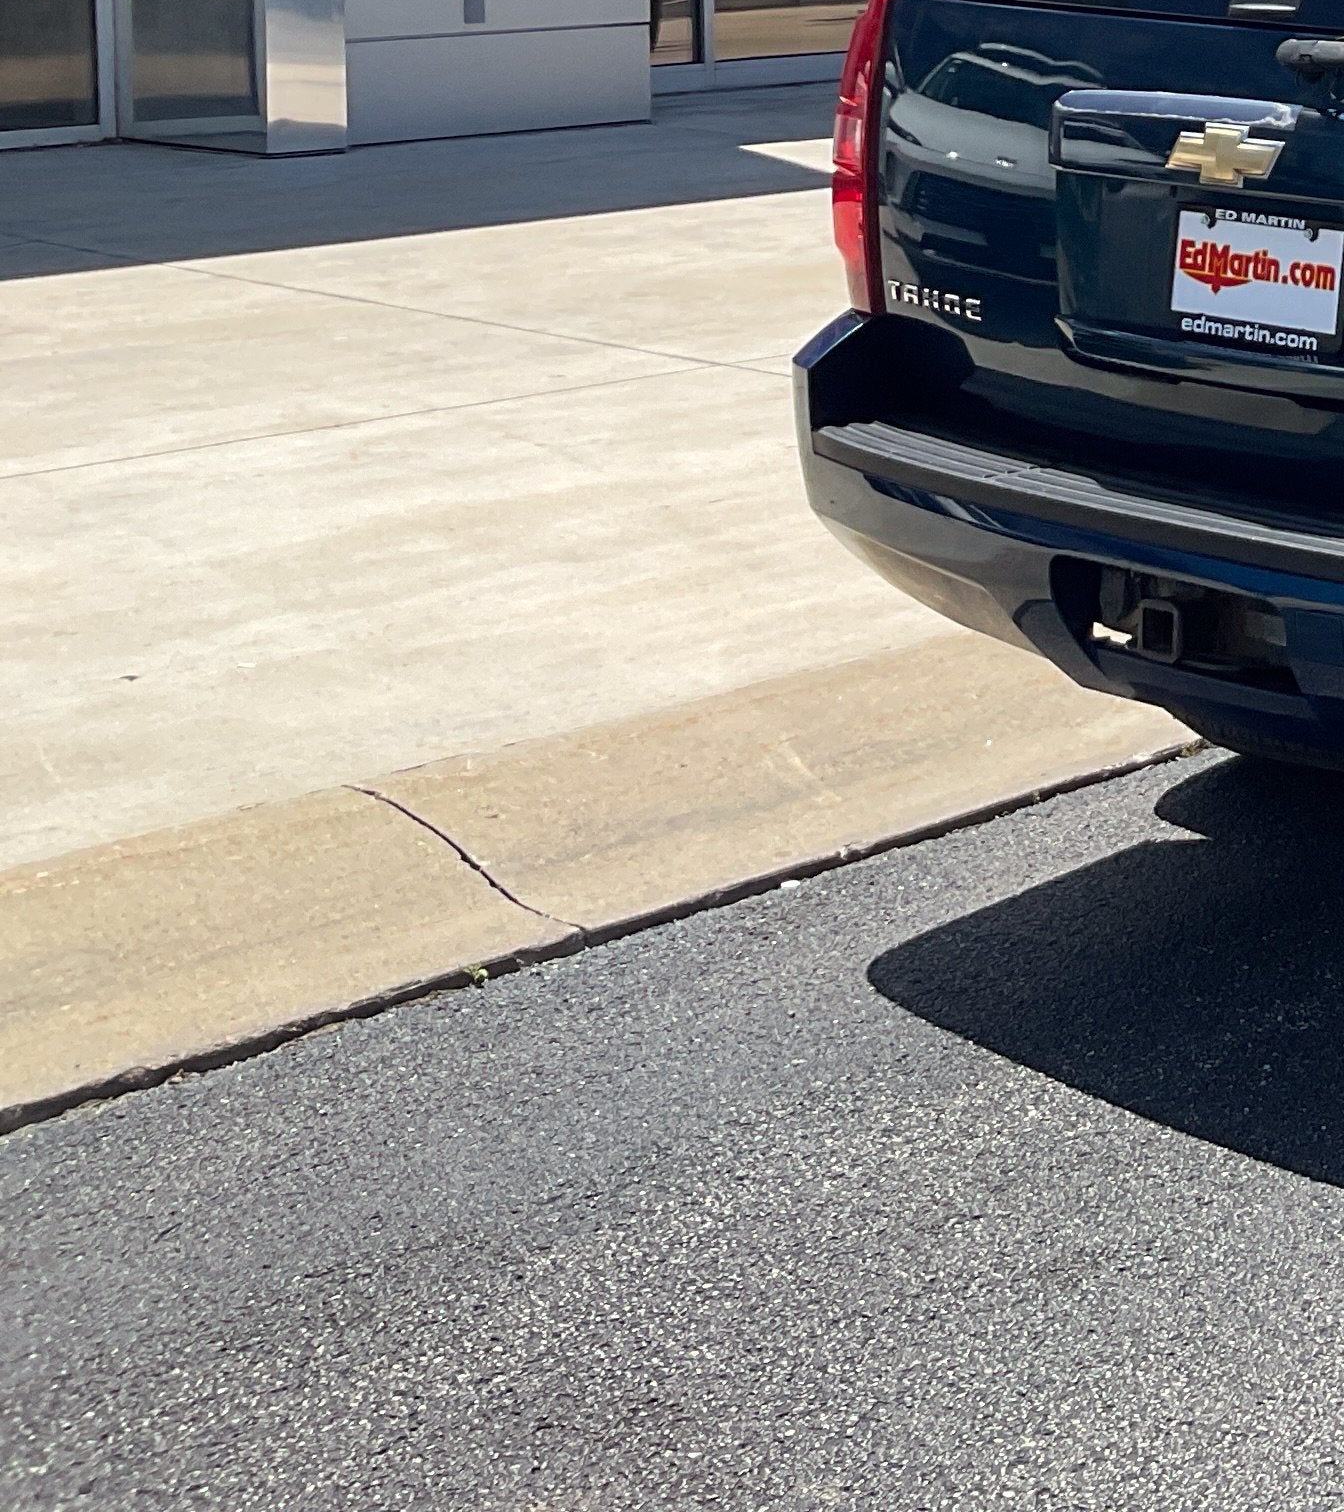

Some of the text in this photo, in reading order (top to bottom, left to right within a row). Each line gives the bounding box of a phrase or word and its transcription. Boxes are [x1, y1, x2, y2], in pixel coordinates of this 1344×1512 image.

[1215, 208, 1306, 231] ED MARTIN
[1179, 238, 1336, 292] EdMartin.com
[887, 279, 982, 322] TAHOE
[1181, 315, 1318, 351] edmartin.com
